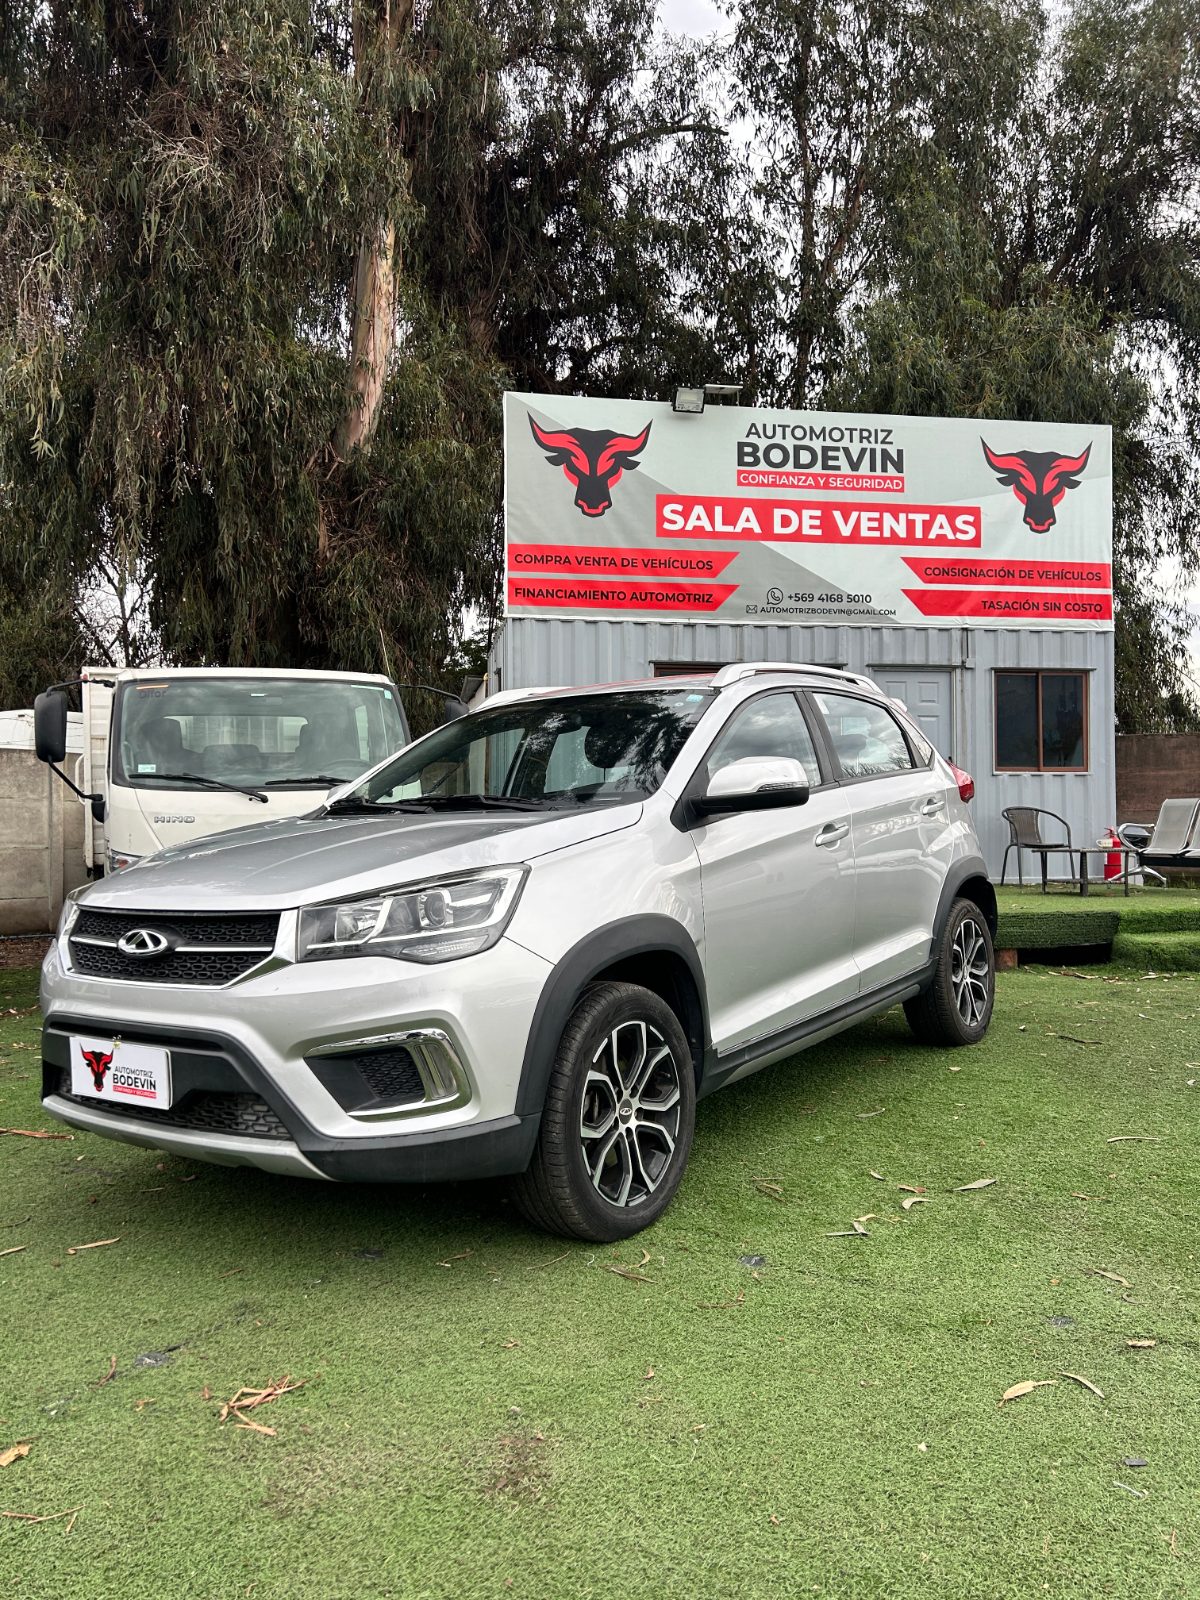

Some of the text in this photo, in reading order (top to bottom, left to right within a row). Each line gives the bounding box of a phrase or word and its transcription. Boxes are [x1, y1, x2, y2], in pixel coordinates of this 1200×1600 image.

[745, 423, 893, 445] AUTOMOTRIZ
[737, 441, 904, 474] BODEVIN
[740, 473, 903, 490] CONFIANZA Y SEGURIDAD
[662, 503, 976, 541] SALA DE VENTAS
[514, 553, 713, 570] COMPRA VENTA DE VEHÍCULOS
[924, 566, 1102, 581] CONSIGNACIÓN DE VEHÍCULOS
[514, 587, 713, 604] FINANCIAMIENTO AUTOMOTRIZ
[787, 593, 872, 604] +569 4168 5010
[760, 606, 897, 616] AUTOMOTRIZBODEVIN@GMAIL.COM
[981, 599, 1103, 613] TASACIÓN SIN COSTO
[154, 816, 196, 824] HINO
[114, 1066, 153, 1079] AUTOMOTRIZ
[113, 1073, 156, 1091] BODEVIN
